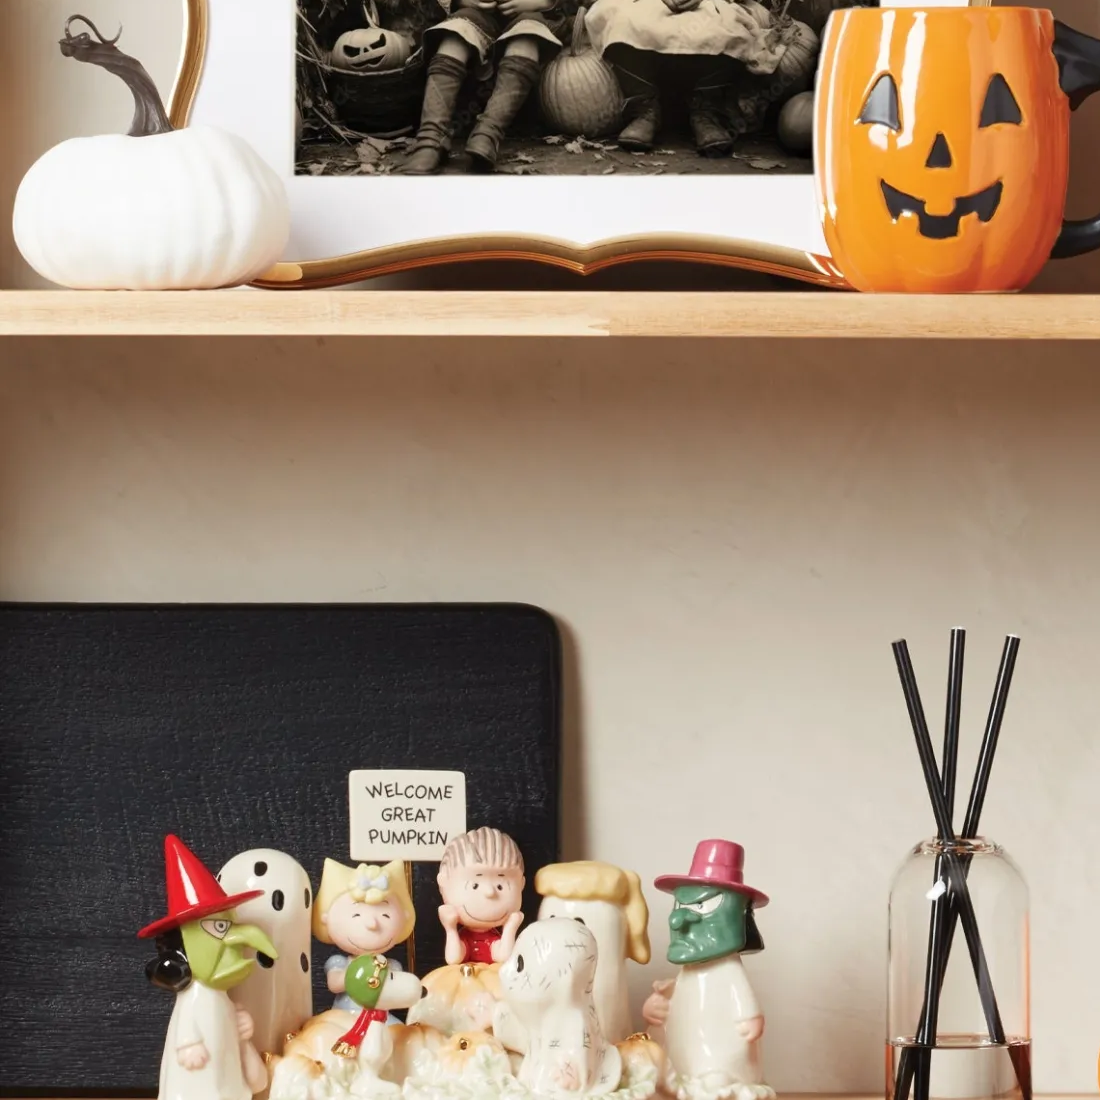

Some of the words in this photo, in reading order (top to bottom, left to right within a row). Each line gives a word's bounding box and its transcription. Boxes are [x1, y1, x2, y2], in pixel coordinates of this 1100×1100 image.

[365, 781, 453, 801] WELCOME
[381, 806, 436, 823] GREAT
[368, 828, 448, 846] PUMPKIN
